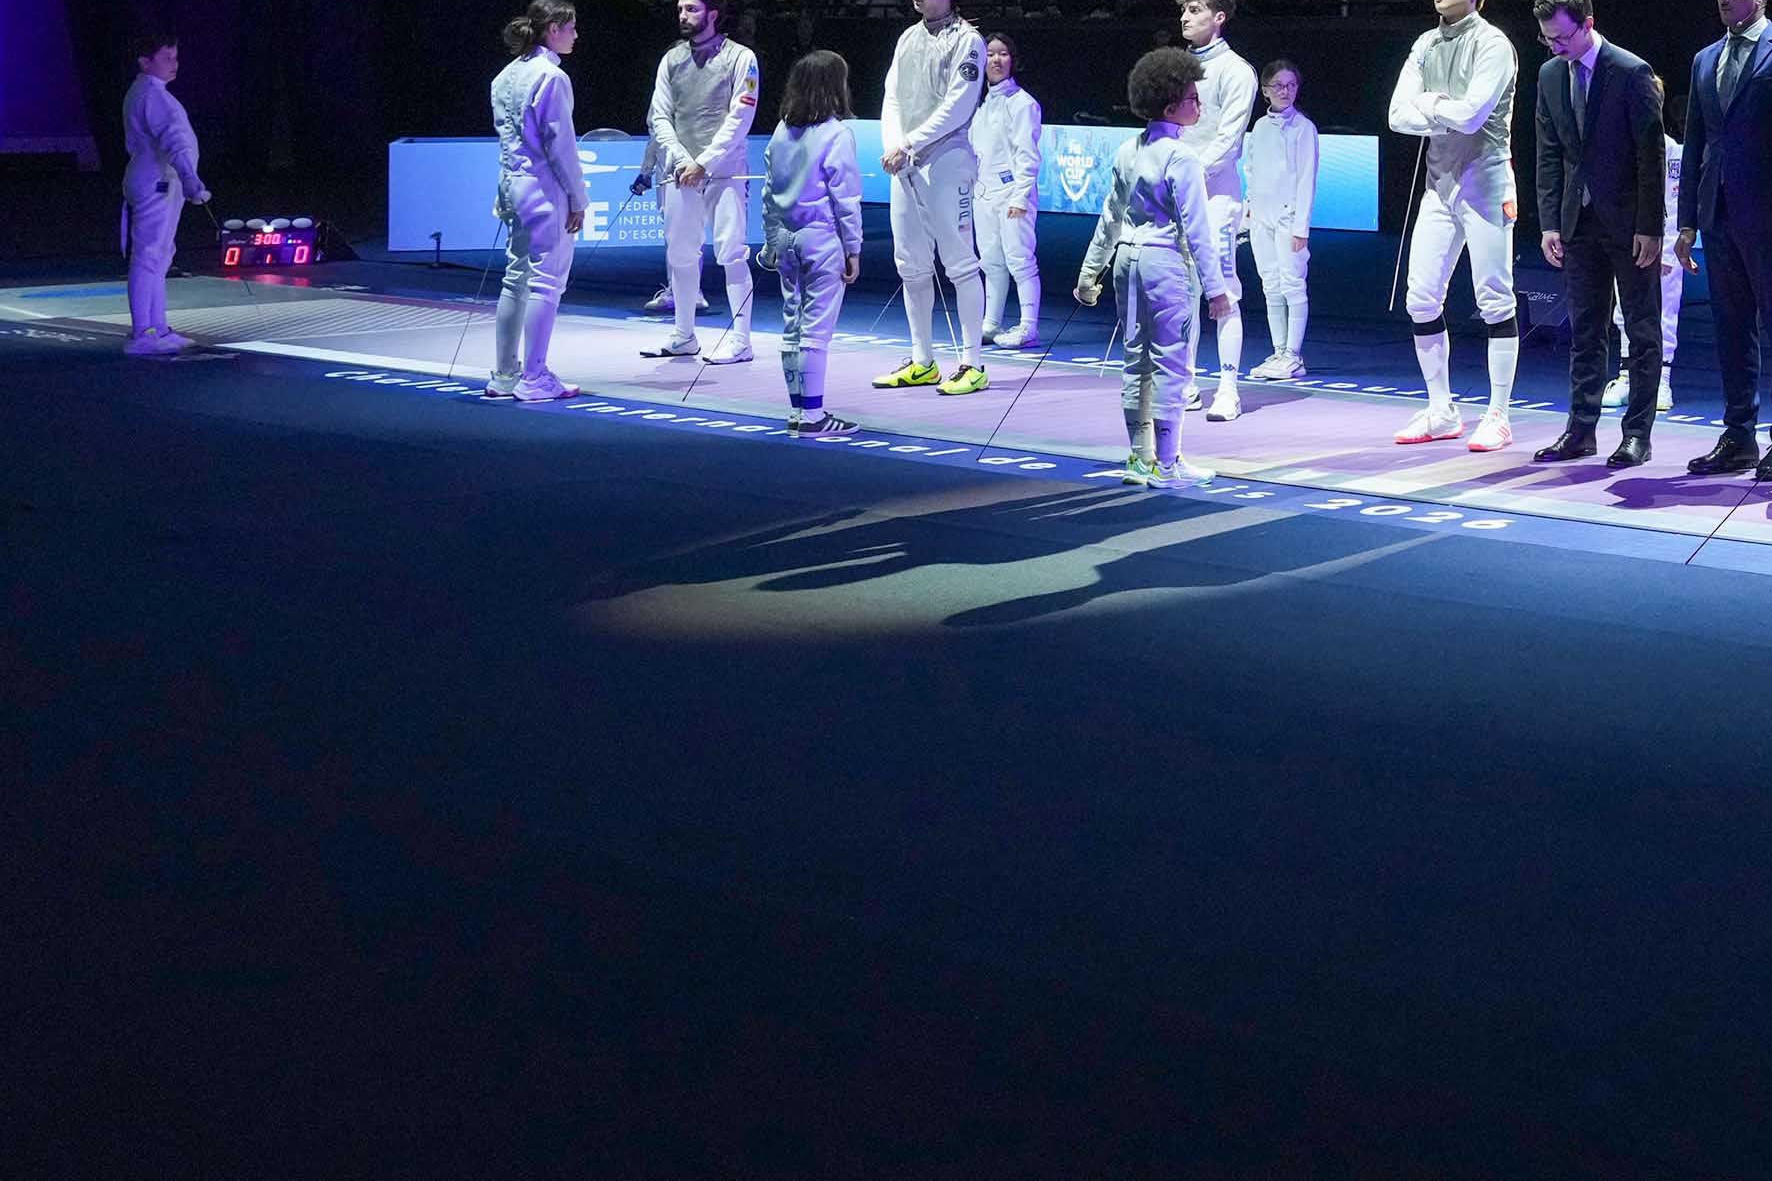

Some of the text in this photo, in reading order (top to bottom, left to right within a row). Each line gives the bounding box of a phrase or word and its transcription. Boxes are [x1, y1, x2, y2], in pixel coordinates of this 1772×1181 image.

[619, 215, 664, 225] INTERN
[619, 230, 664, 240] D'ESCR
[224, 247, 240, 266] 0
[294, 246, 310, 264] 0
[566, 402, 971, 456] Internaonal
[1303, 498, 1517, 530] 2026
